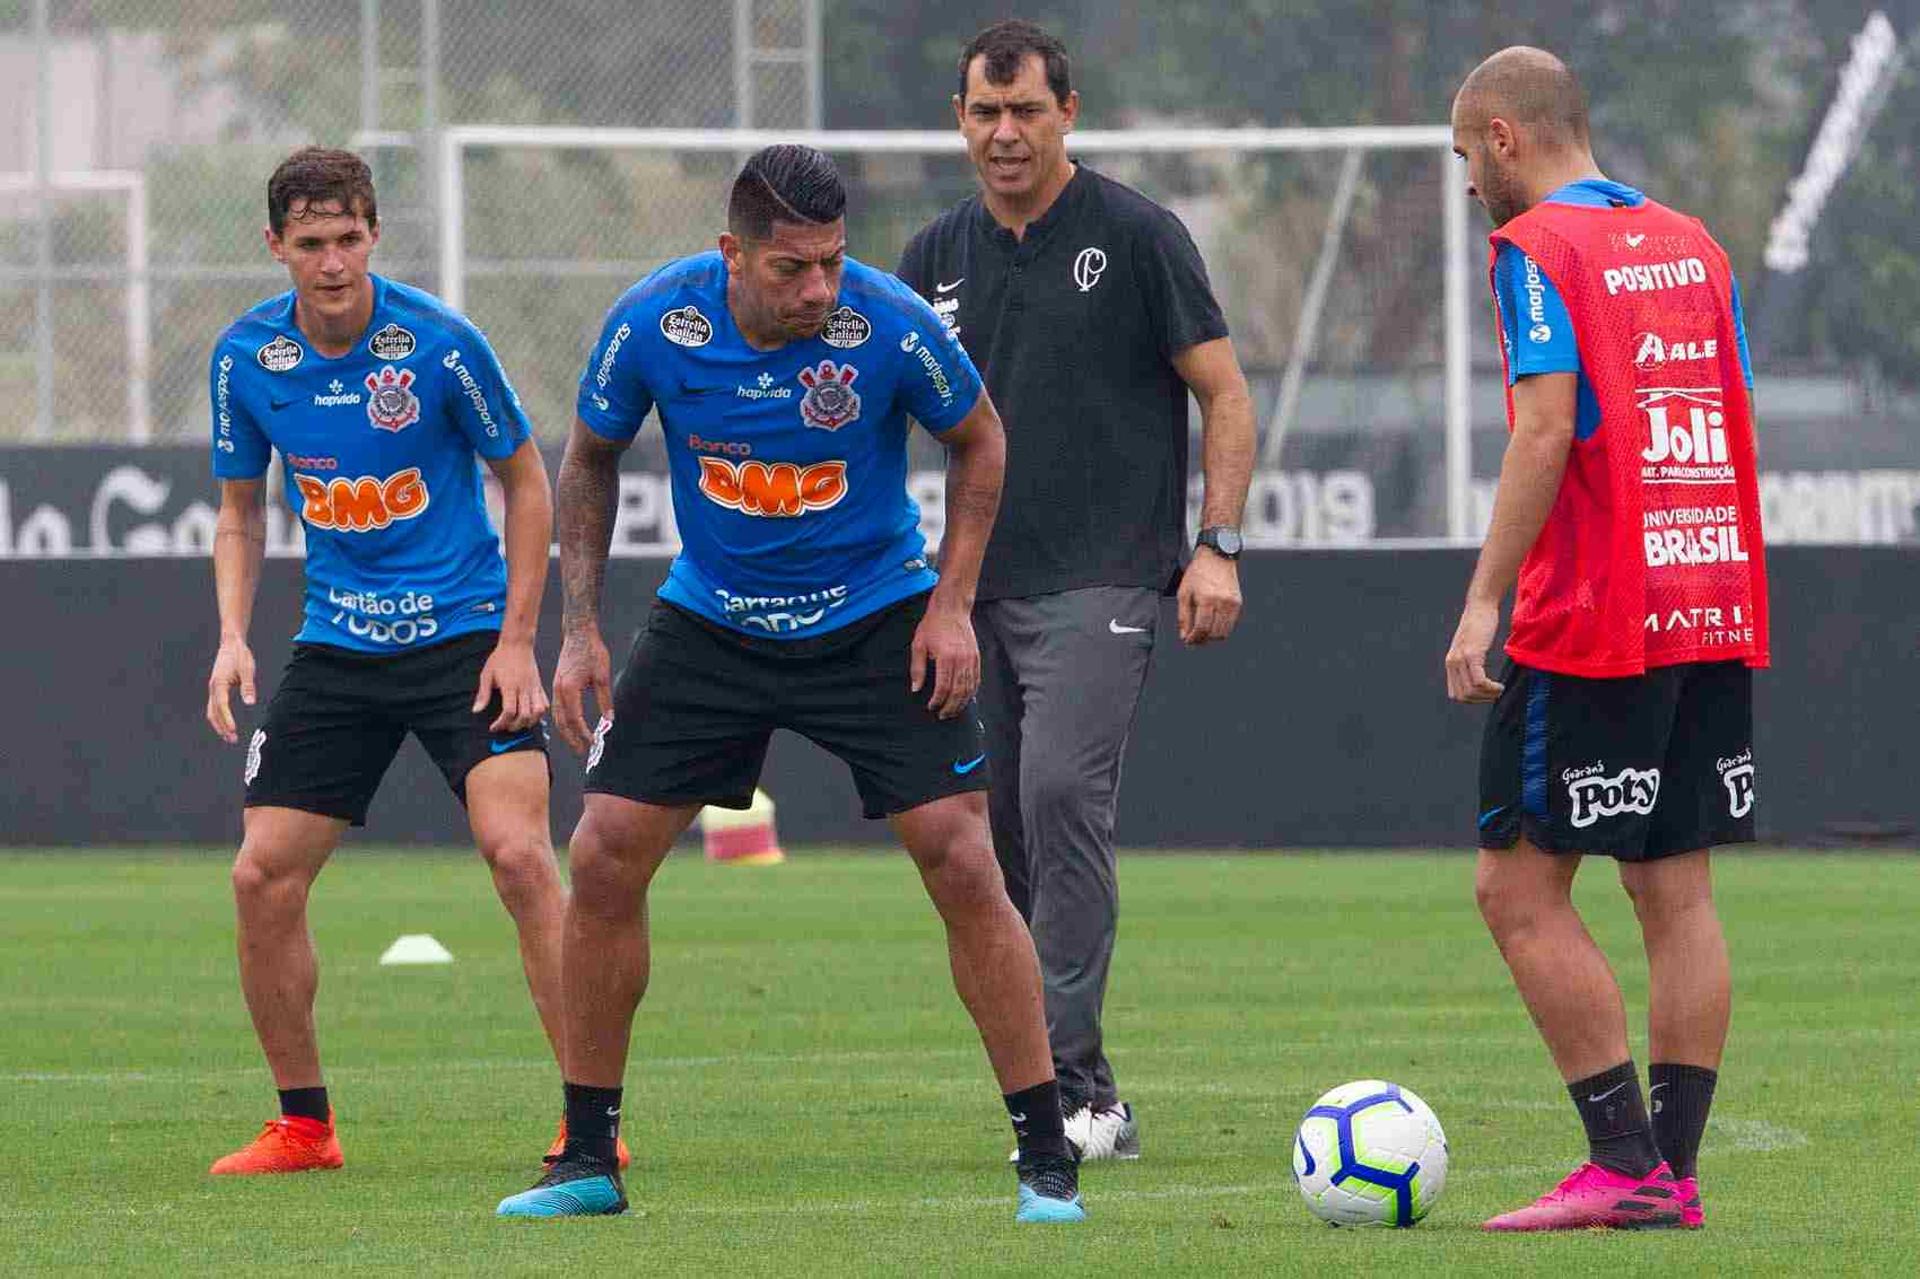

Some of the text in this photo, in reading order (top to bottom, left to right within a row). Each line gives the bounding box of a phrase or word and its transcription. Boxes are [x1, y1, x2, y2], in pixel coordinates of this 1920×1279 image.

[1603, 257, 1707, 296] POSITIVO
[314, 394, 361, 407] hapvida
[737, 384, 792, 400] hapvida
[688, 434, 751, 455] Banco
[1641, 407, 1728, 464] Joli
[294, 467, 430, 533] BMG
[1644, 526, 1749, 568] BRASIL
[399, 591, 434, 614] de
